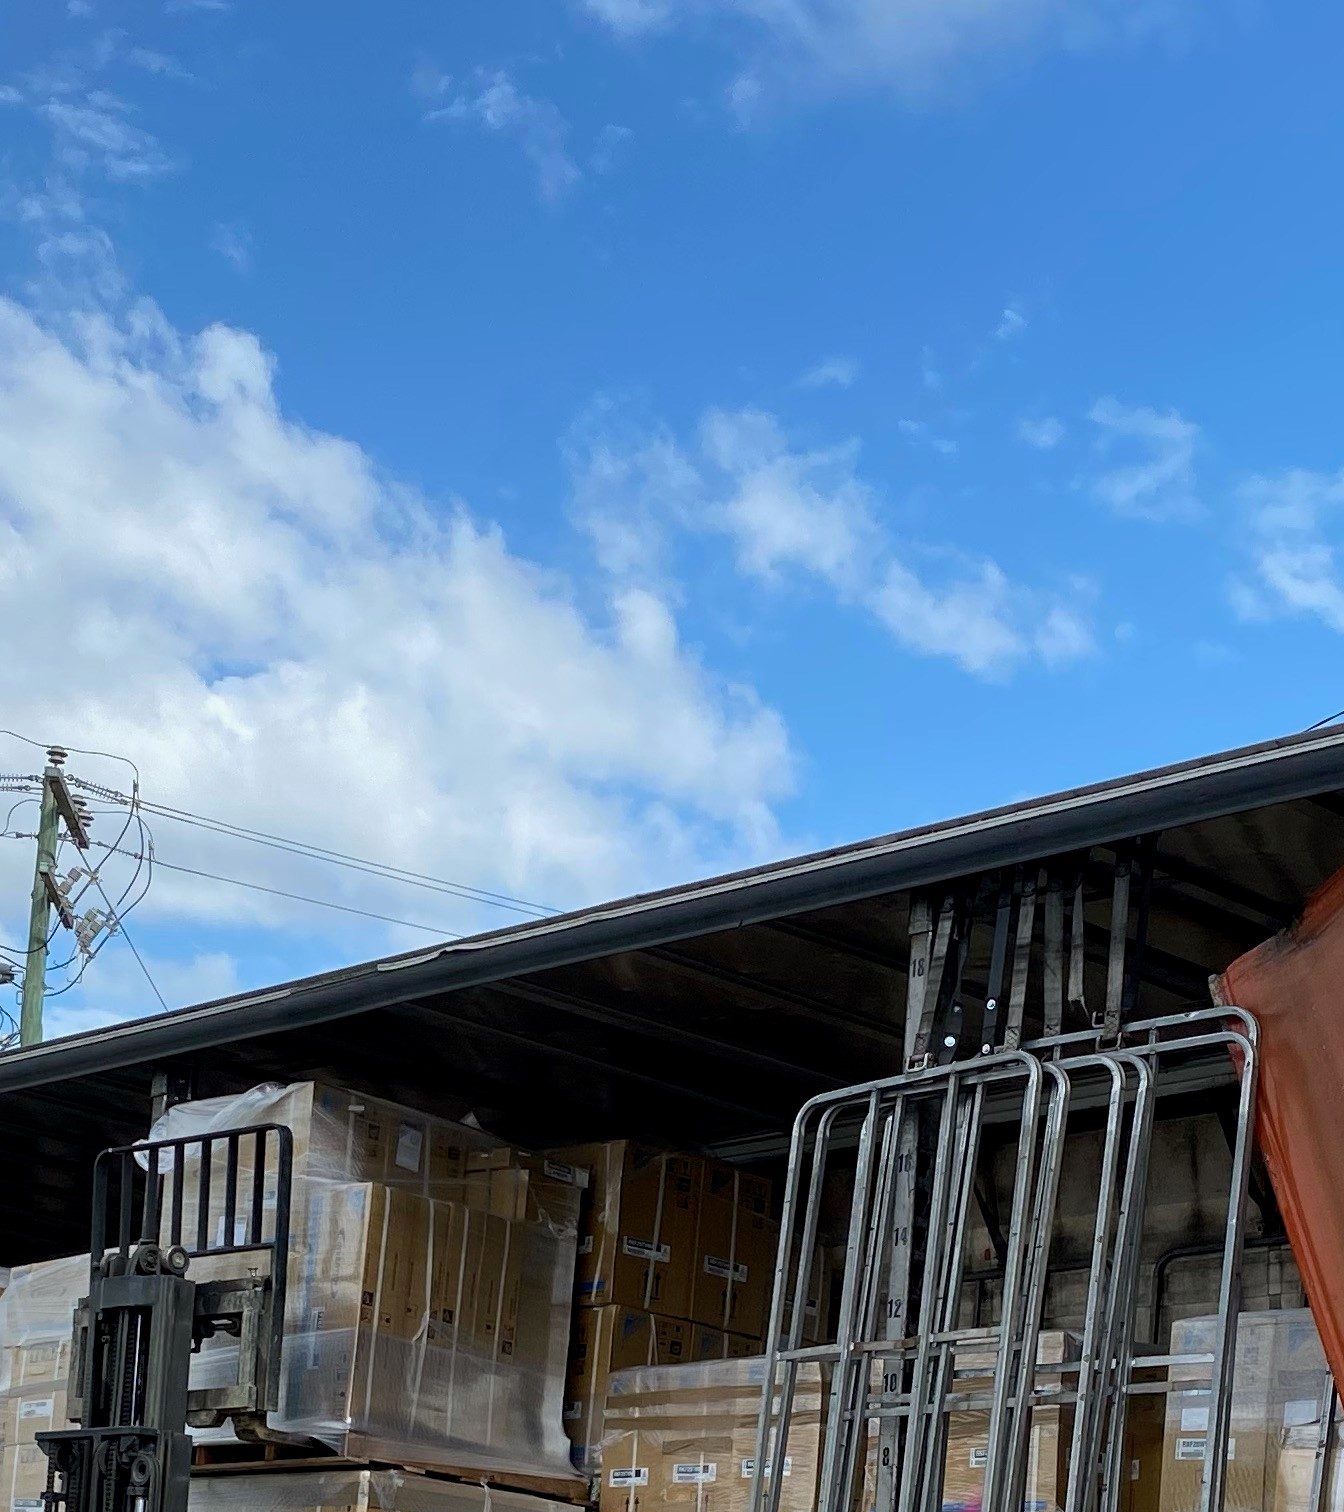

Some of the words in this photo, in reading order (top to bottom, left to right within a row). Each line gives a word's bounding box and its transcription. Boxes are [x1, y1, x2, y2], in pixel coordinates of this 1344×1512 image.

[913, 957, 925, 977] 18
[898, 1153, 912, 1173] 16
[893, 1226, 908, 1247] 14
[887, 1299, 902, 1319] 12
[883, 1373, 897, 1393] 10
[882, 1446, 890, 1467] 8
